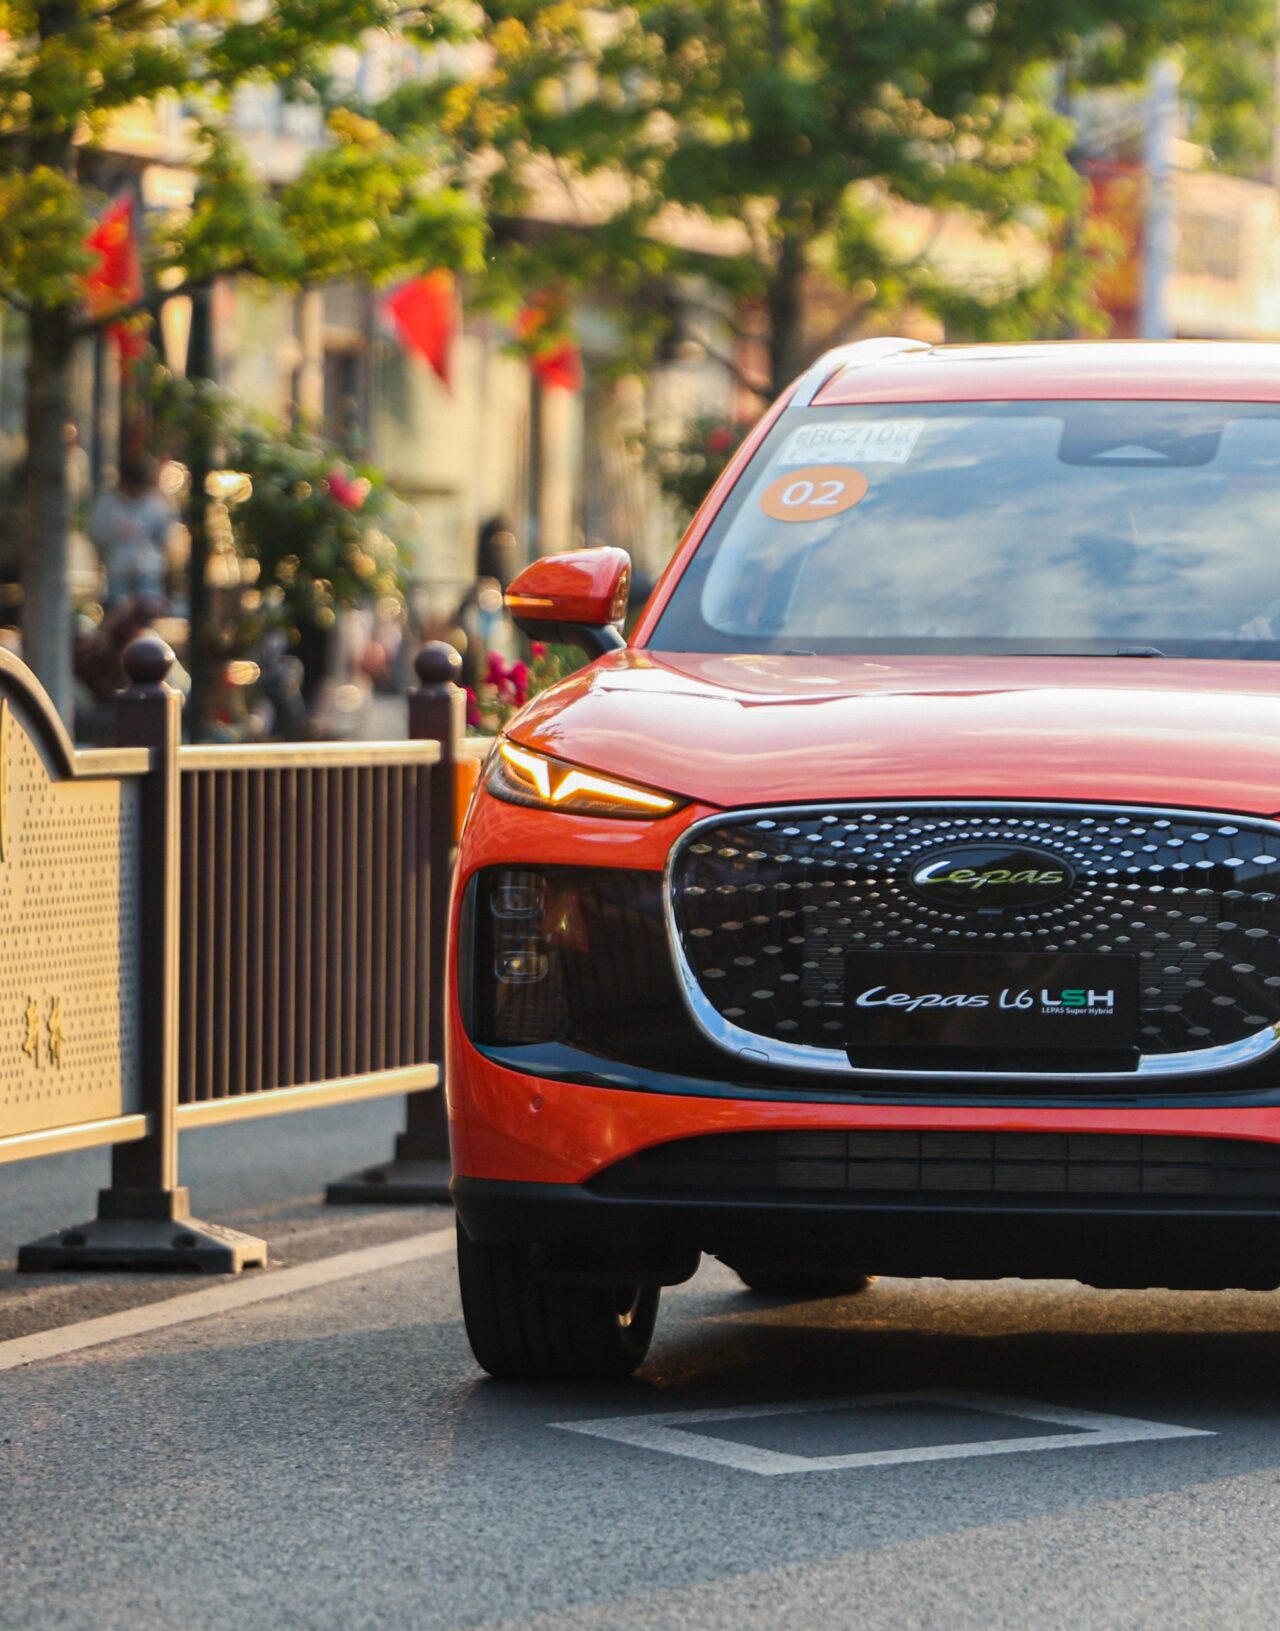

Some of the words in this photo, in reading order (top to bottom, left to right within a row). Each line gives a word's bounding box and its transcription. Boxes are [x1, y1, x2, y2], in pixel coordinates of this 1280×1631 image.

[781, 480, 845, 506] 02
[914, 861, 1064, 889] Lepas
[856, 986, 990, 1012] Lepas
[999, 988, 1034, 1009] L6
[1041, 989, 1114, 1007] LSH
[1066, 1007, 1087, 1015] Super
[1088, 1007, 1114, 1015] Hybrid
